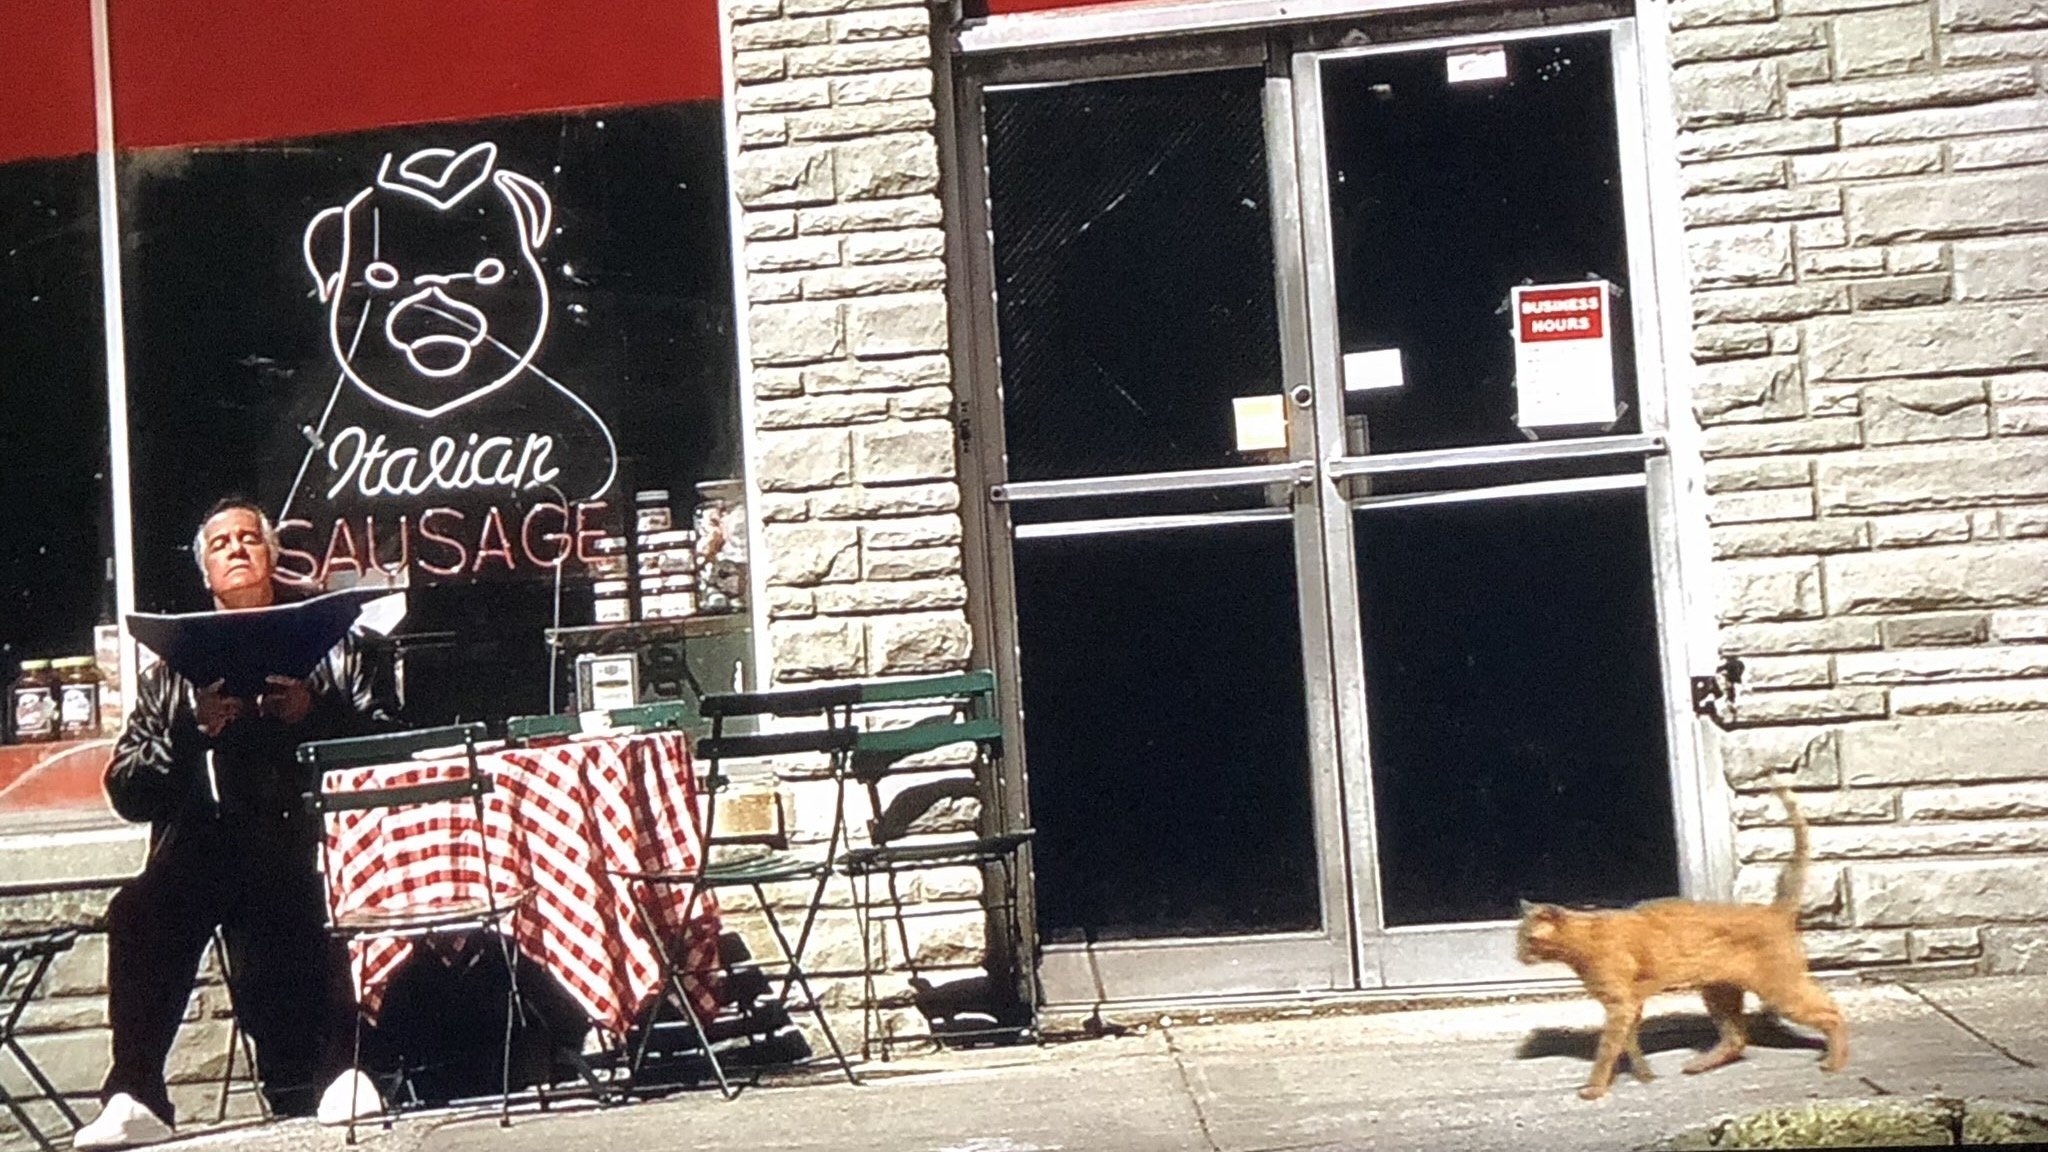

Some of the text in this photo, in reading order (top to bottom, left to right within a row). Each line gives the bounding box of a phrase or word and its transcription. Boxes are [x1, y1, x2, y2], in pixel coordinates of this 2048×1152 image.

[1522, 297, 1598, 314] BUSINESS
[1532, 317, 1590, 333] HOURS
[327, 426, 559, 499] Italian
[272, 501, 608, 590] SAUSAGE
